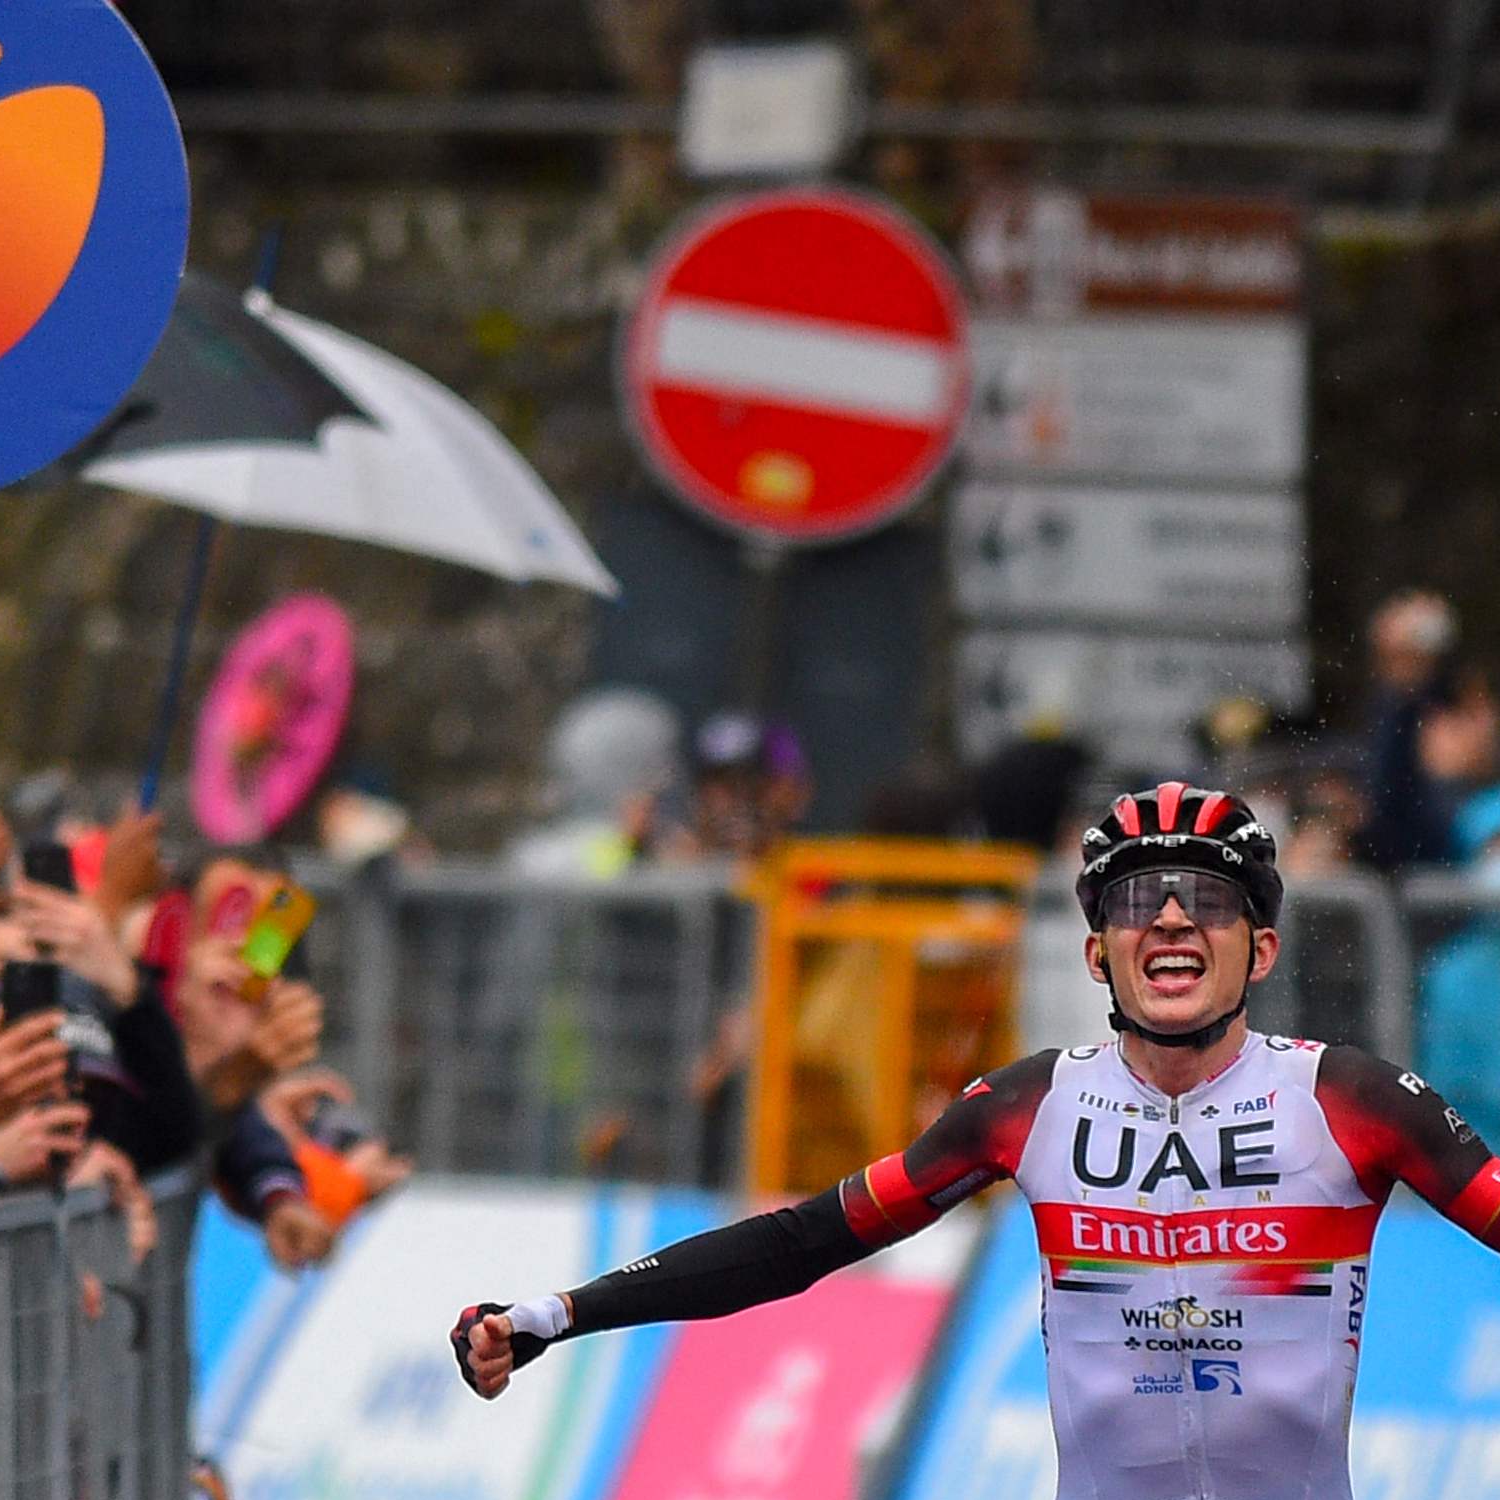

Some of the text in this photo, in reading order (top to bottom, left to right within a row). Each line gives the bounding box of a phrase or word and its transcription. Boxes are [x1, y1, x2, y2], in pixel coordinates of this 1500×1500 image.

[1141, 835, 1192, 848] MET
[1233, 1096, 1269, 1115] FAB
[1072, 1116, 1281, 1194] UAE
[1069, 1211, 1288, 1258] Emirates
[1348, 1264, 1367, 1334] FAB
[1121, 1307, 1244, 1330] WHOOSH
[1145, 1337, 1244, 1352] COLNAGO
[1133, 1385, 1185, 1395] ADNOC
